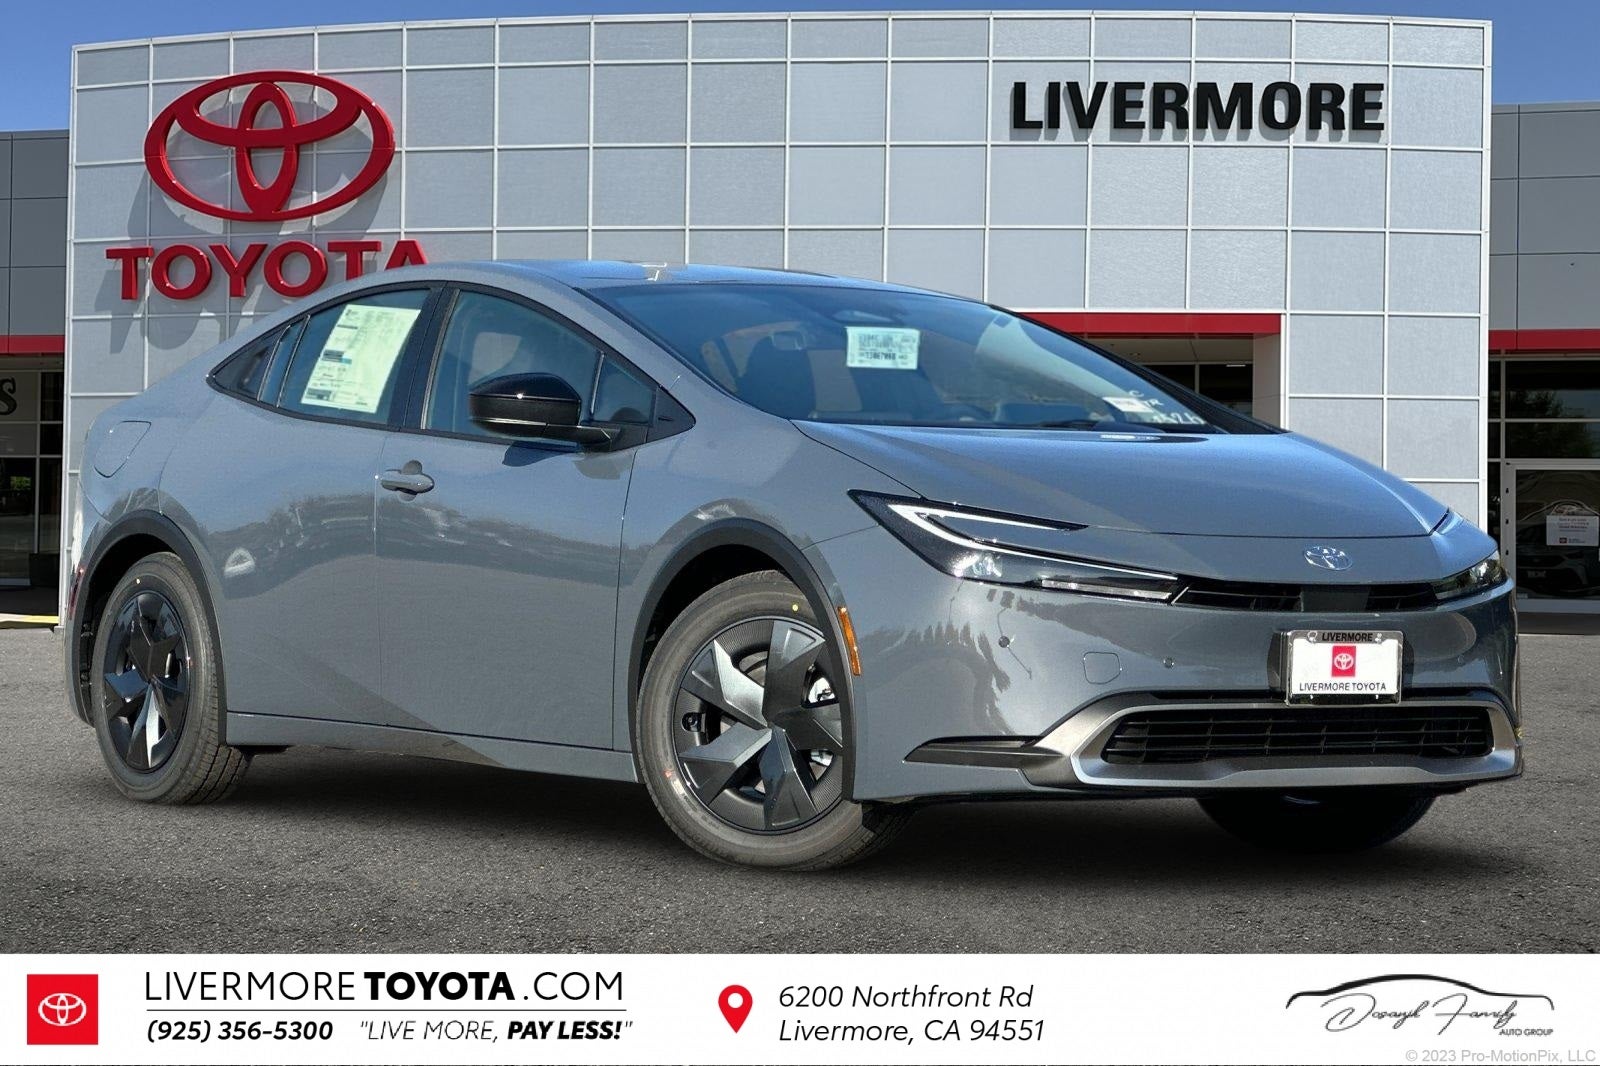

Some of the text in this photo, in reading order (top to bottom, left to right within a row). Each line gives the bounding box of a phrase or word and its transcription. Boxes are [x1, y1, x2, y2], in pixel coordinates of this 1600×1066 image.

[1013, 81, 1384, 131] LIVERMORE
[1322, 632, 1373, 642] LIVERMORE
[1299, 682, 1387, 692] LIVERMORE TOYOTA
